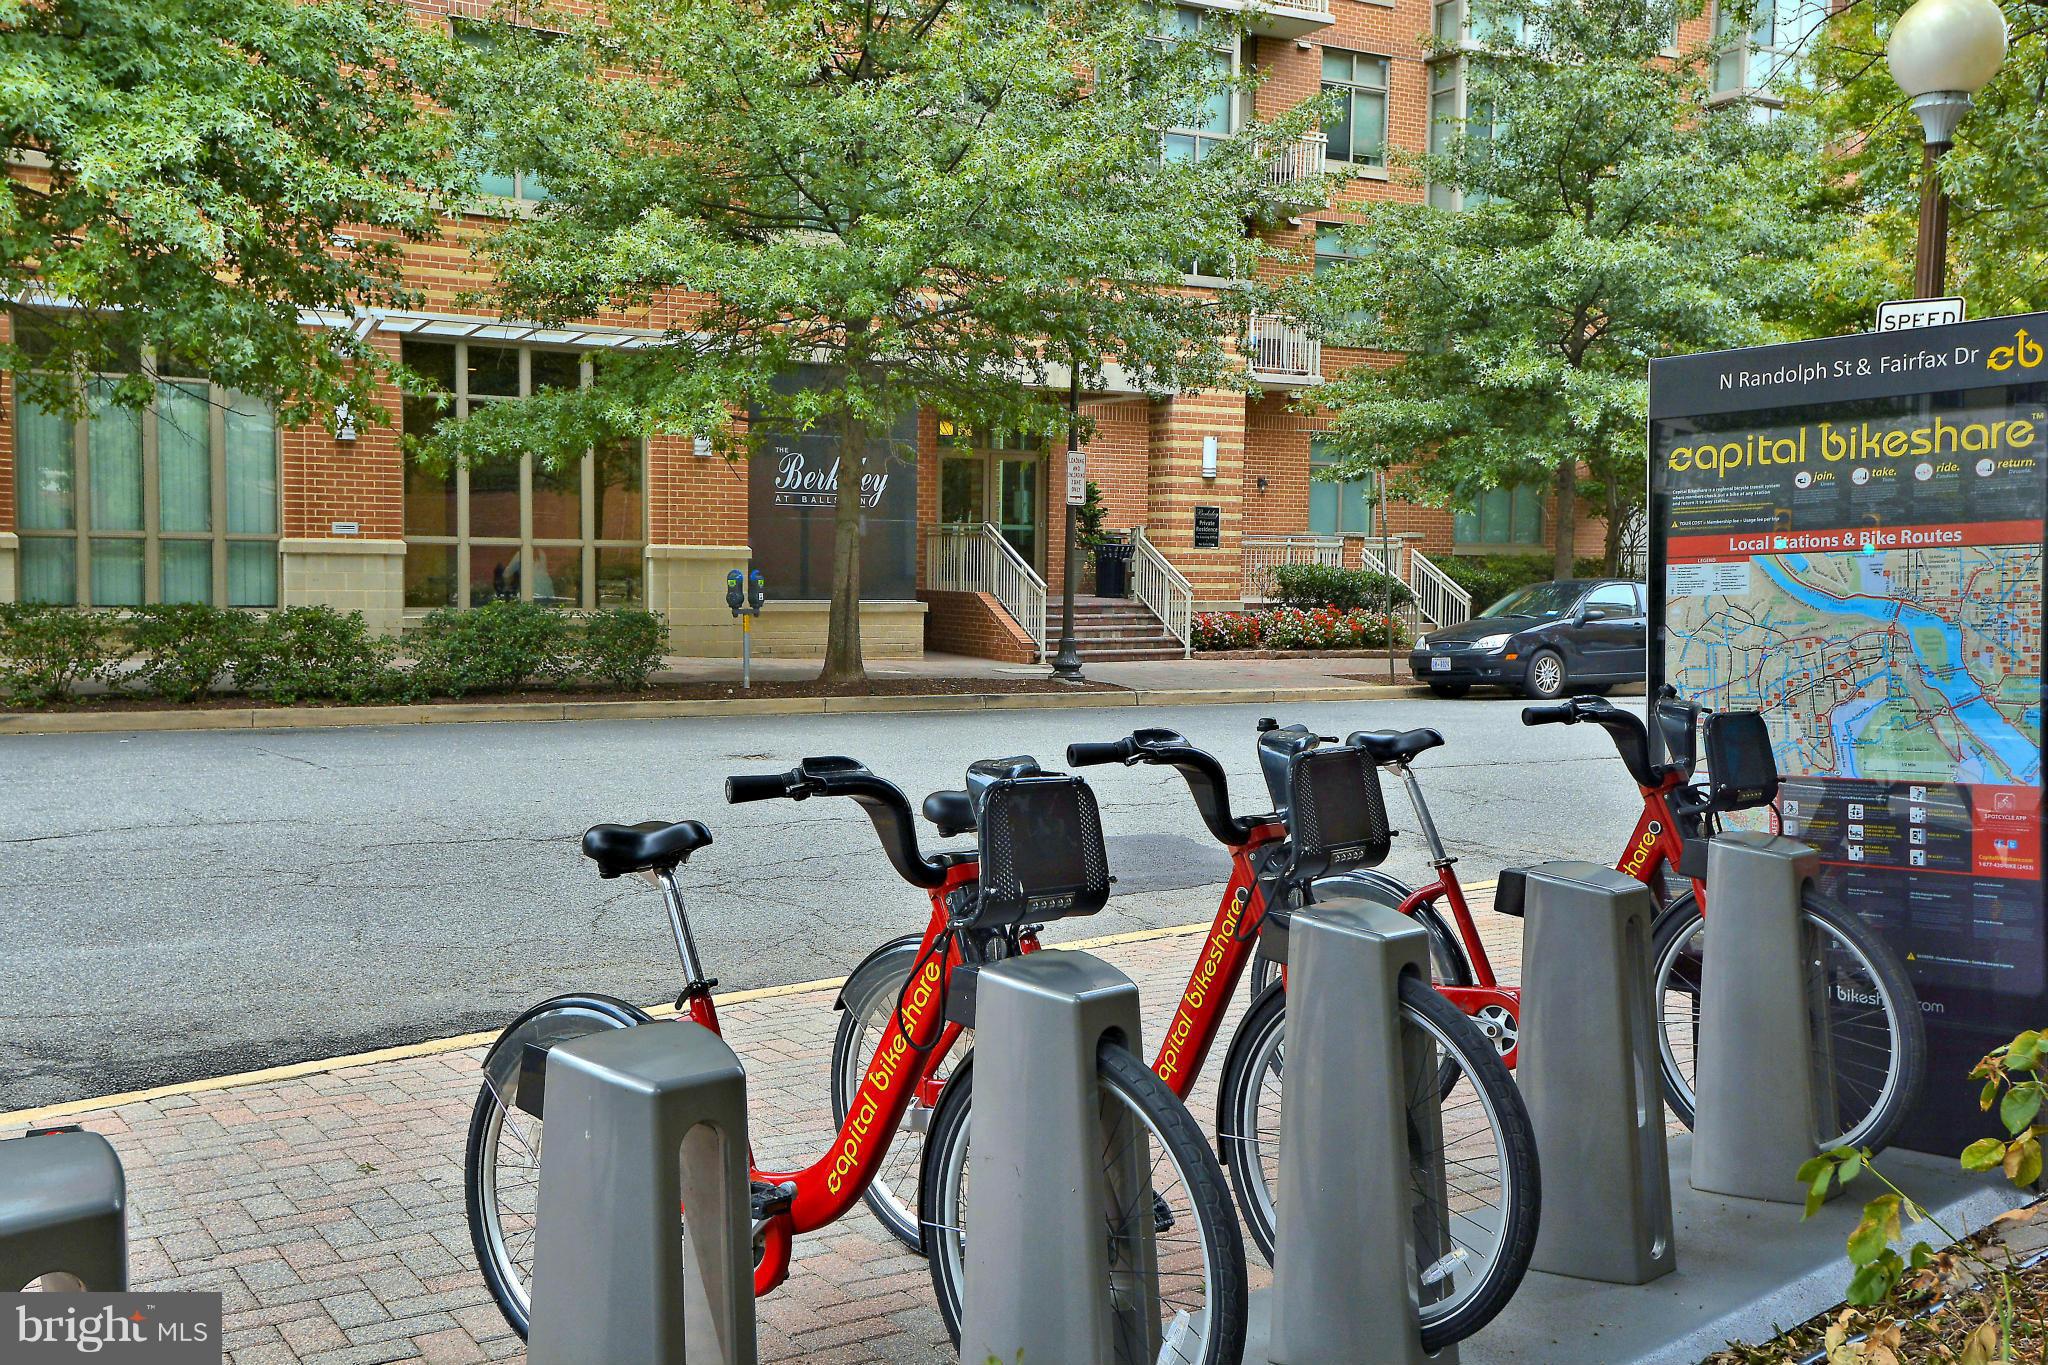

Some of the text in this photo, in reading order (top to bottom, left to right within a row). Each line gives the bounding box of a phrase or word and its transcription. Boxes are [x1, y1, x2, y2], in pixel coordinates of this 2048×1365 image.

[1884, 311, 1956, 330] SPEED
[1720, 347, 1979, 390] N Randolph St & Fairfax Dr
[1668, 427, 1806, 478] capital
[1818, 416, 2035, 461] bikeshare
[1872, 467, 1897, 477] take.
[1936, 462, 1960, 472] ride.
[1997, 458, 2036, 469] return.
[774, 452, 889, 508] Berkey
[1813, 471, 1835, 483] join.
[775, 495, 866, 505] AT BALLN
[1730, 529, 1962, 551] Local Stations & Bike Routes
[1623, 832, 1656, 878] hare
[1158, 898, 1242, 1082] apital bikeshare
[828, 962, 941, 1196] capital bikeshare
